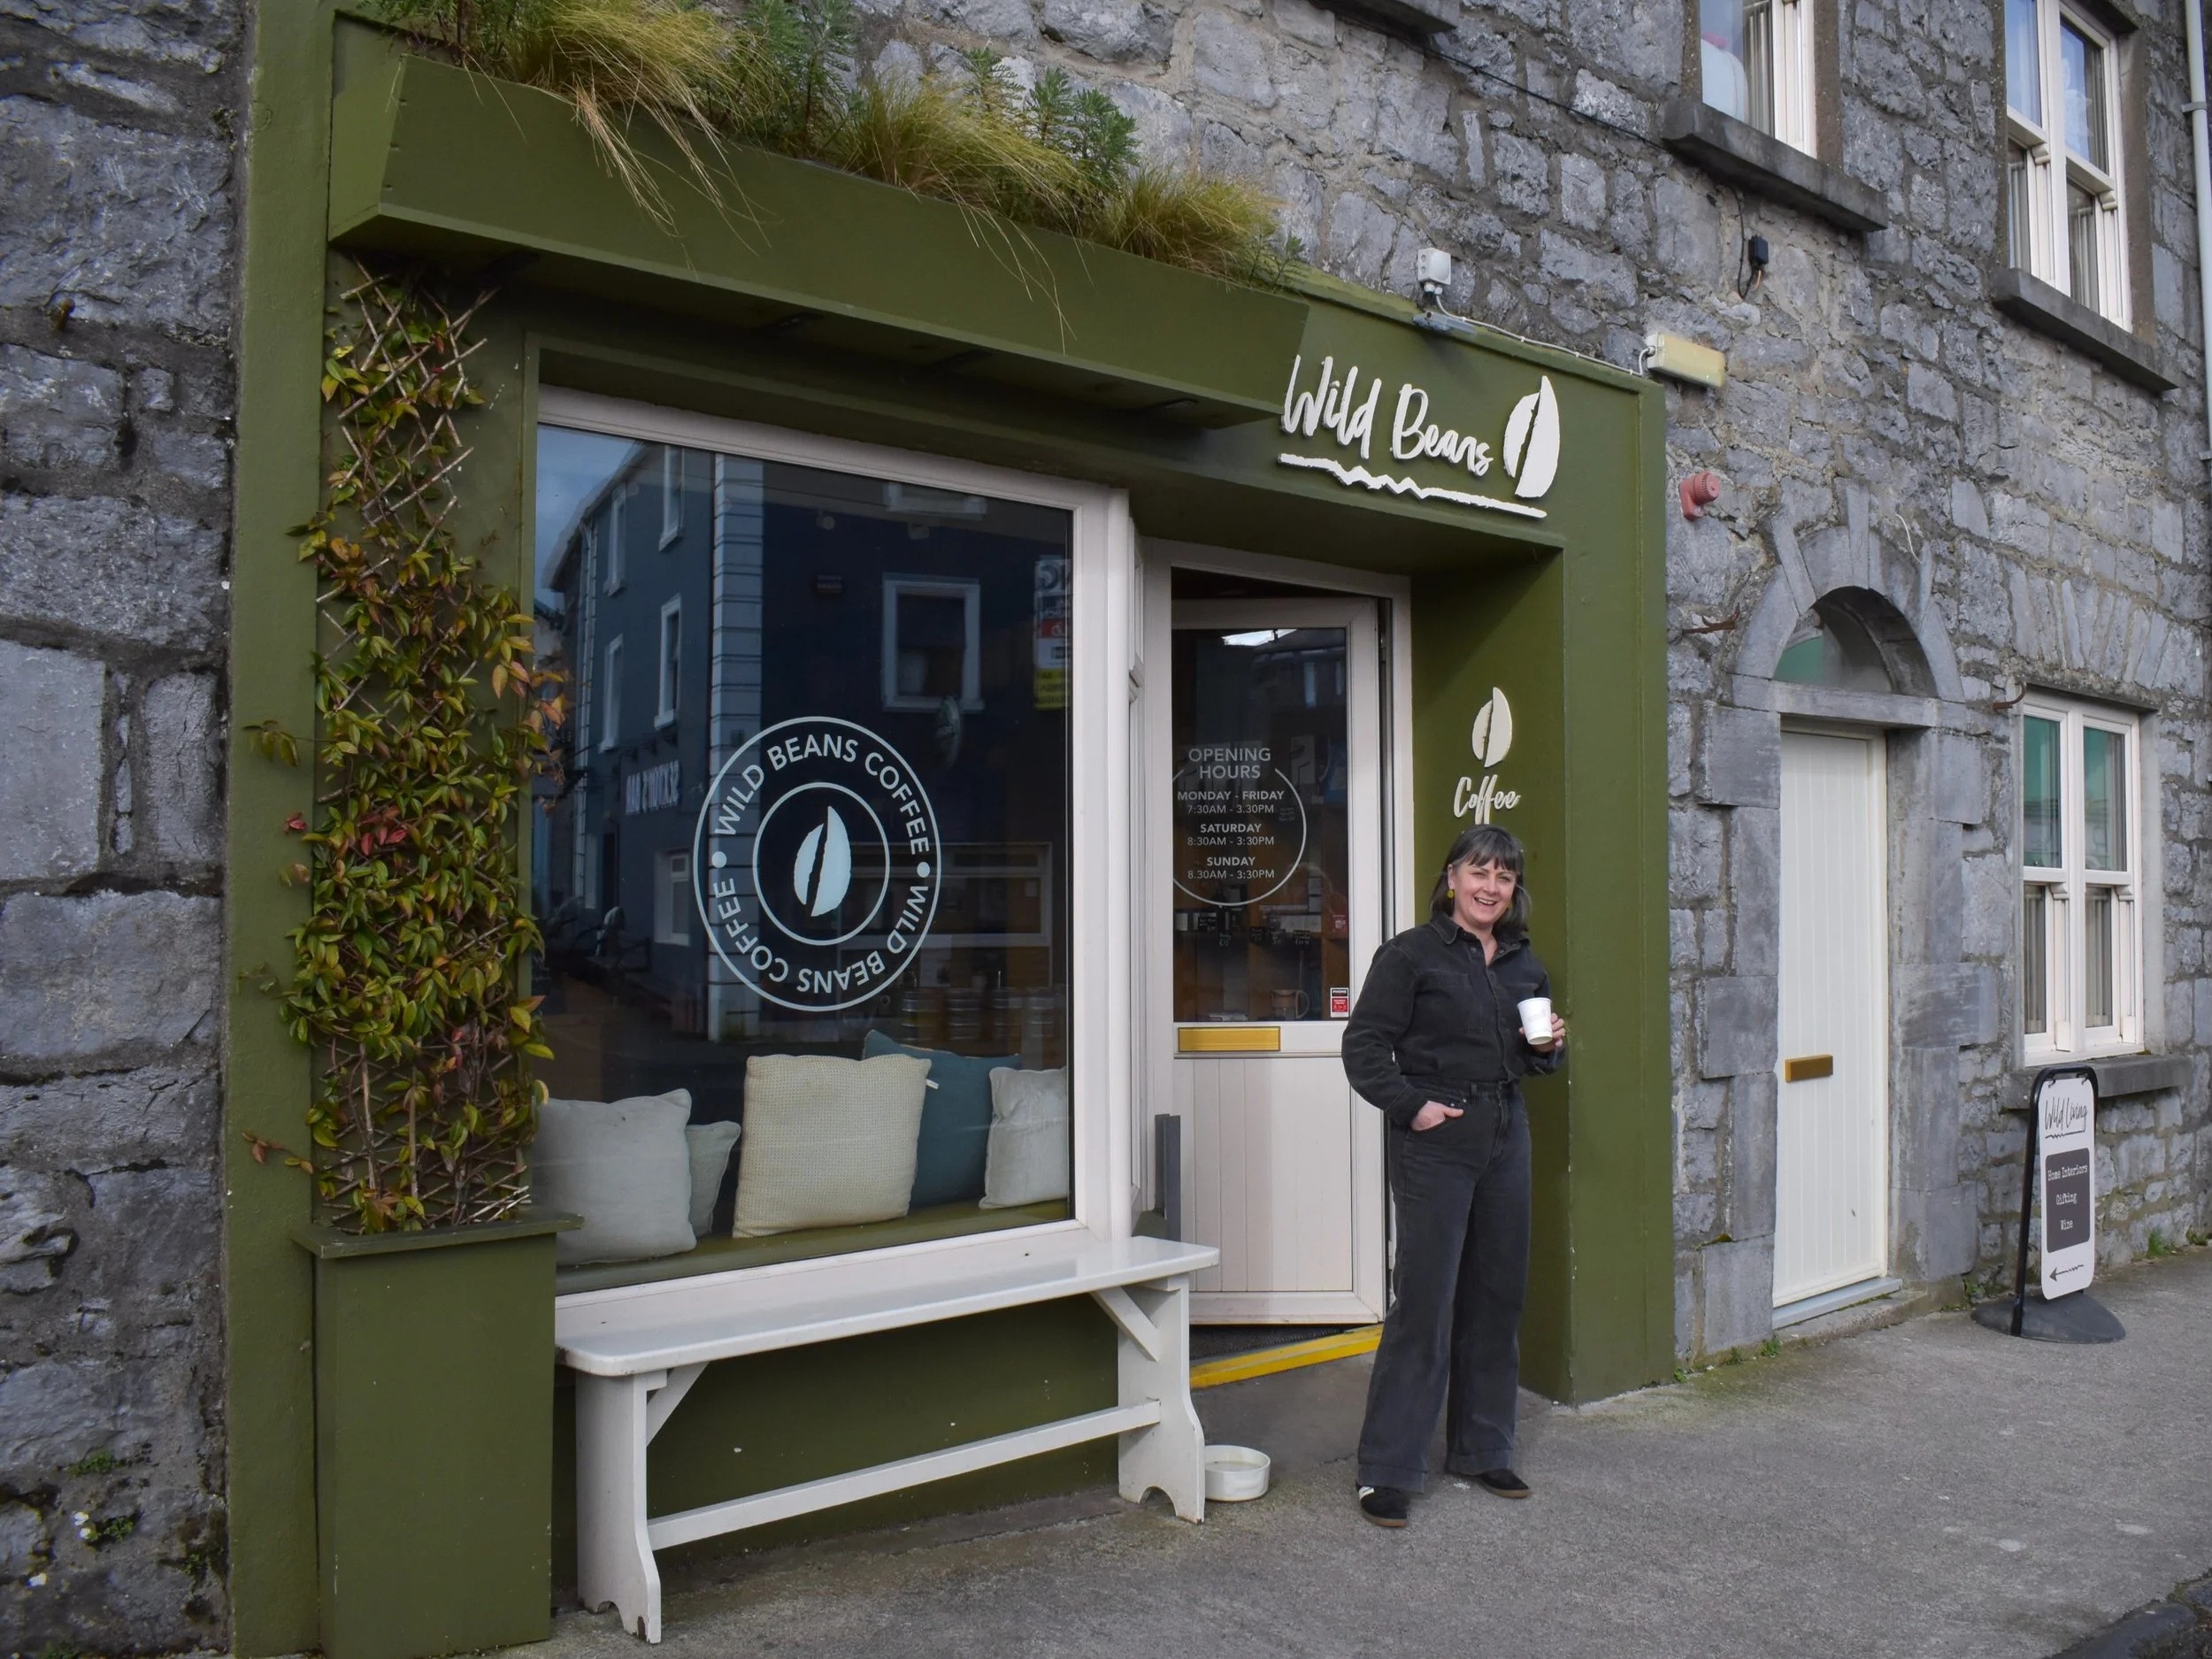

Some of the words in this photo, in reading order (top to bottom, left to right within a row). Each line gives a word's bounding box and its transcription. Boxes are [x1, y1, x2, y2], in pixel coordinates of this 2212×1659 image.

[1281, 354, 1382, 459] Wild
[1391, 383, 1494, 477] Beans
[1188, 748, 1271, 762] OPENING
[1200, 764, 1261, 780] HOURS
[714, 764, 764, 835] WILD
[767, 733, 858, 772] BEANS
[864, 752, 930, 855] COFFEE
[1177, 790, 1232, 801] MONDAY
[1242, 790, 1285, 800] FRIDAY
[1454, 774, 1522, 825] Coffee
[1187, 804, 1226, 814] 7:30AM
[1200, 823, 1262, 833] SATURDAY
[1187, 836, 1226, 846] 8:30AM
[1236, 836, 1275, 846] 3:30PM
[1206, 856, 1256, 866] SUNDAY
[1236, 870, 1275, 879] 3:30PM
[887, 886, 929, 954] WILD
[714, 878, 789, 982] COFFEE
[796, 950, 885, 994] BEANS
[2044, 1096, 2065, 1131] Wild
[2065, 1096, 2088, 1132] Living
[2047, 1170, 2061, 1181] Home
[2062, 1164, 2088, 1179] Interiors
[2055, 1193, 2078, 1206] Gifting
[2060, 1220, 2073, 1231] Wine
